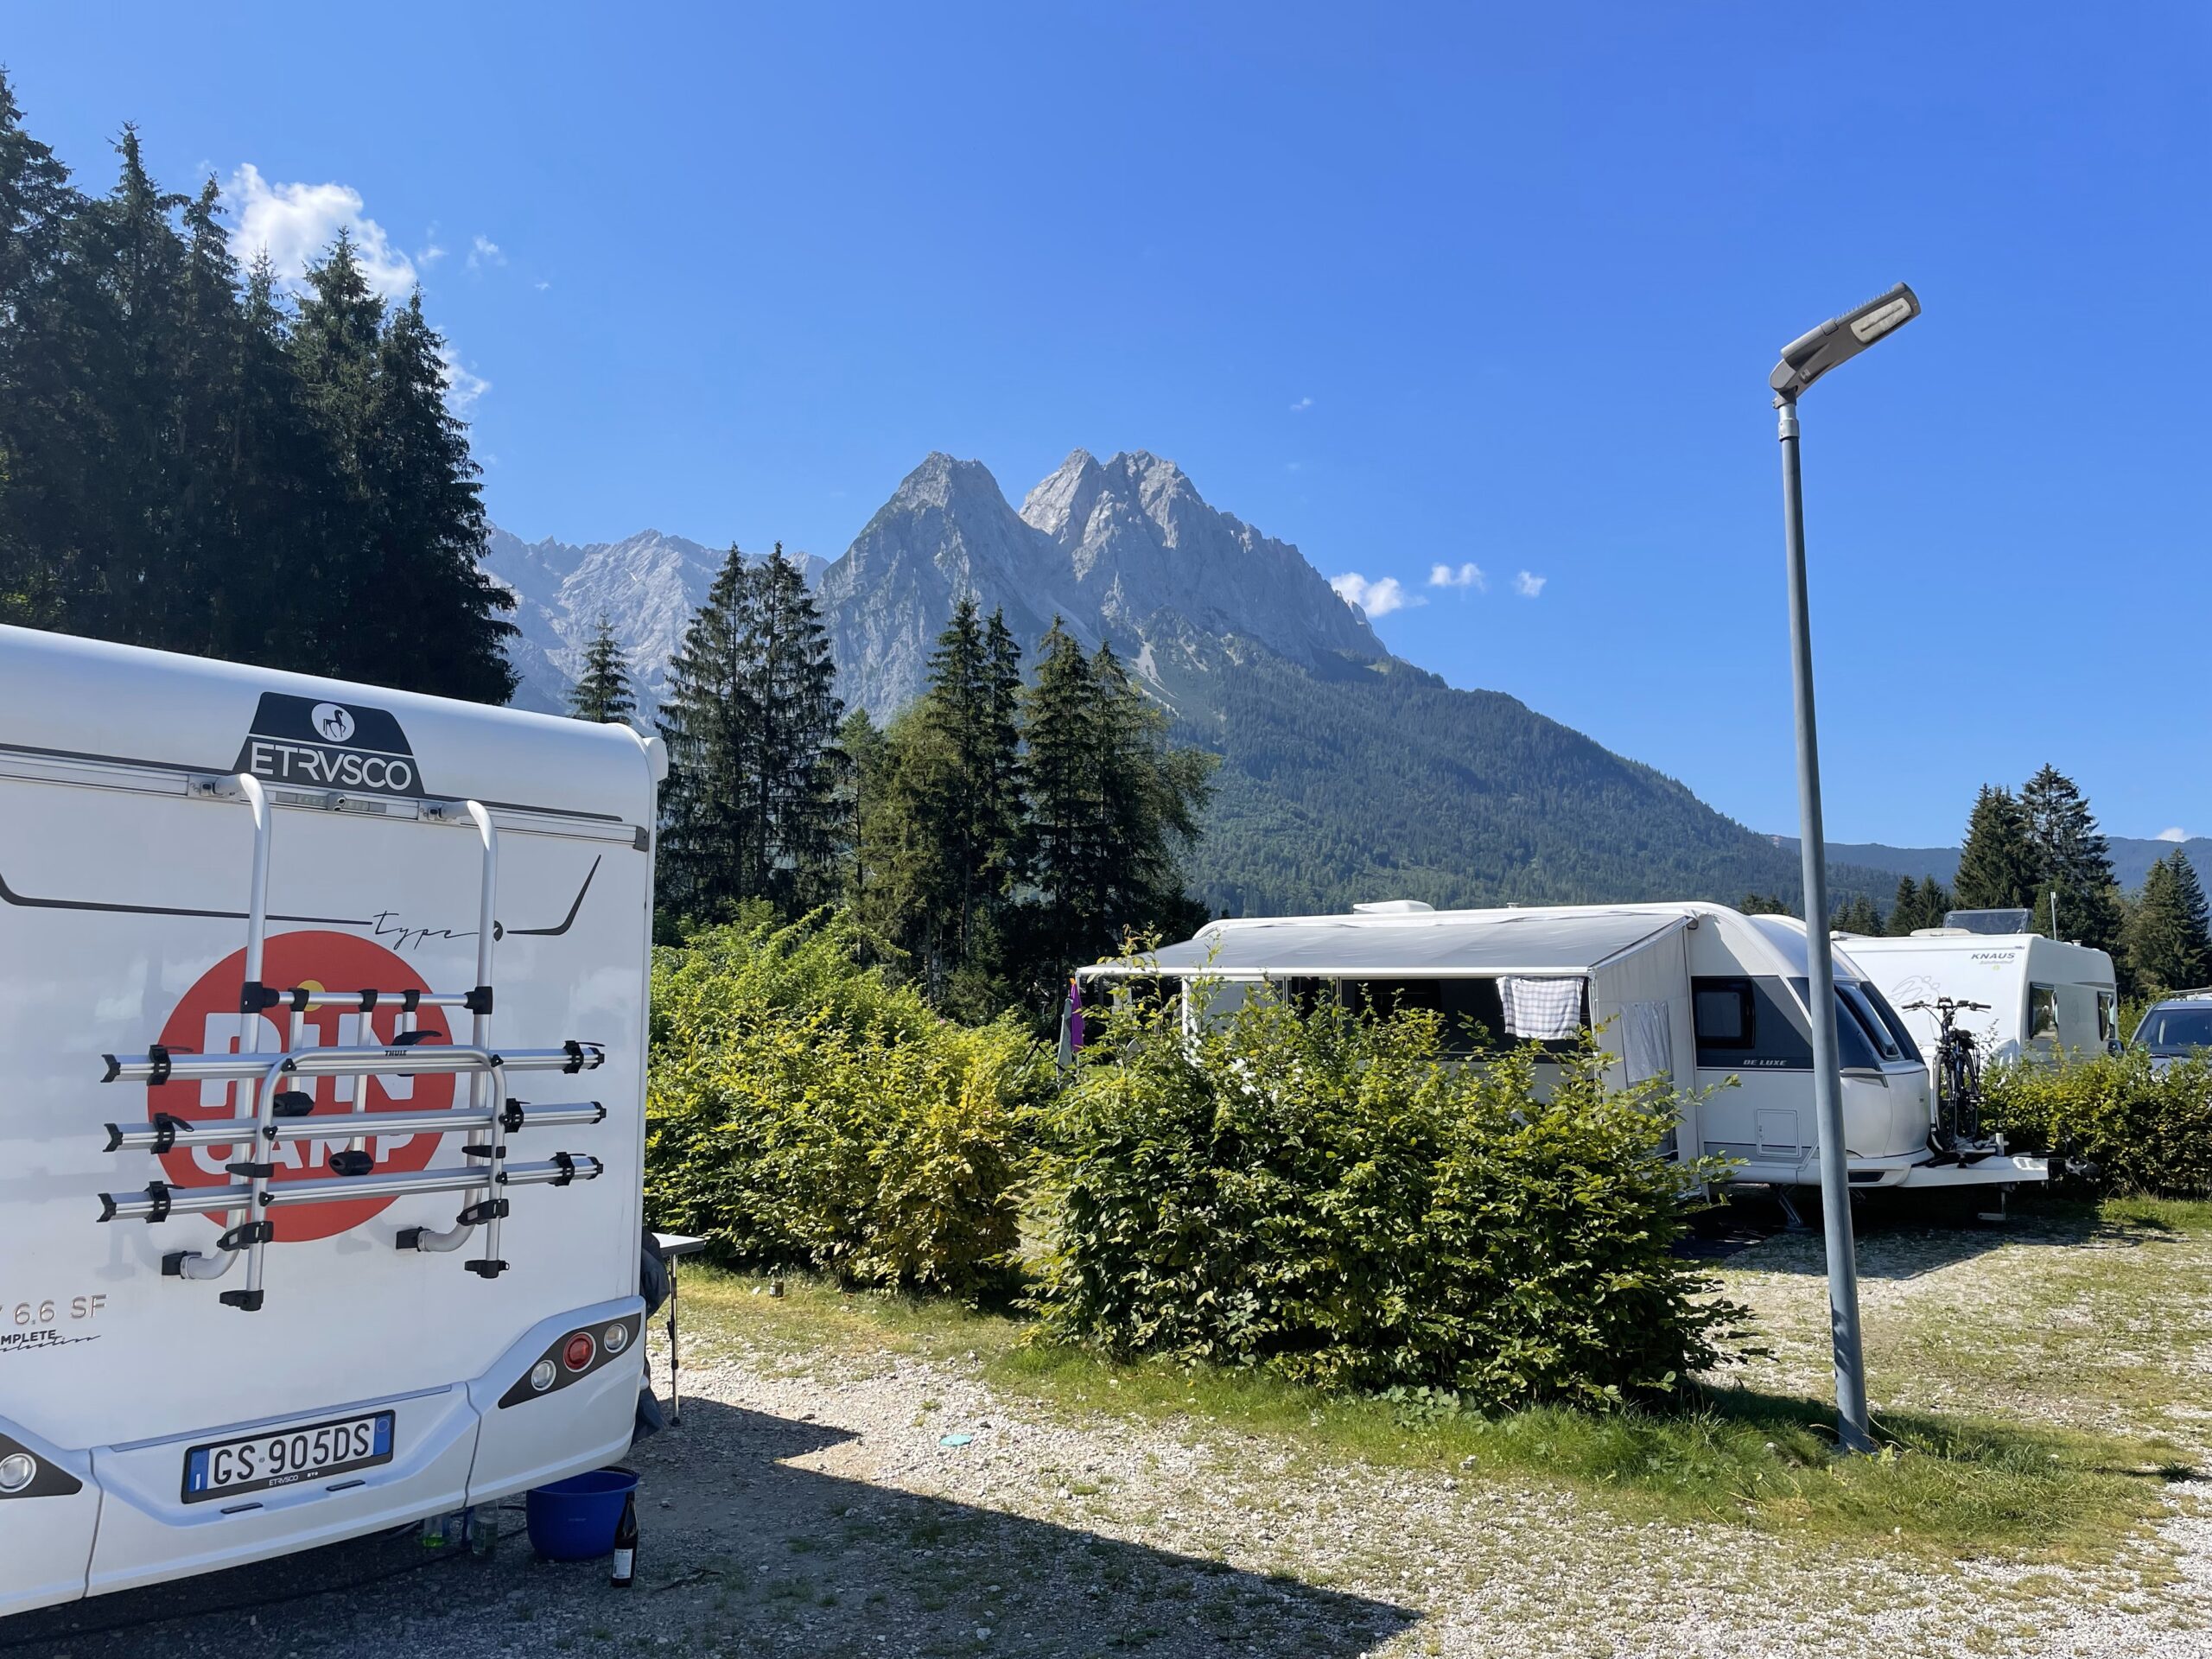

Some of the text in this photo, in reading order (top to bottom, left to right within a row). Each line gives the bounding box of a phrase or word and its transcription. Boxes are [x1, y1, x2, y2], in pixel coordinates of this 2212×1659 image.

[373, 910, 479, 950] type
[13, 1299, 55, 1326] 6.6
[70, 1294, 107, 1319] SF
[214, 1423, 371, 1485] GS 905DS
